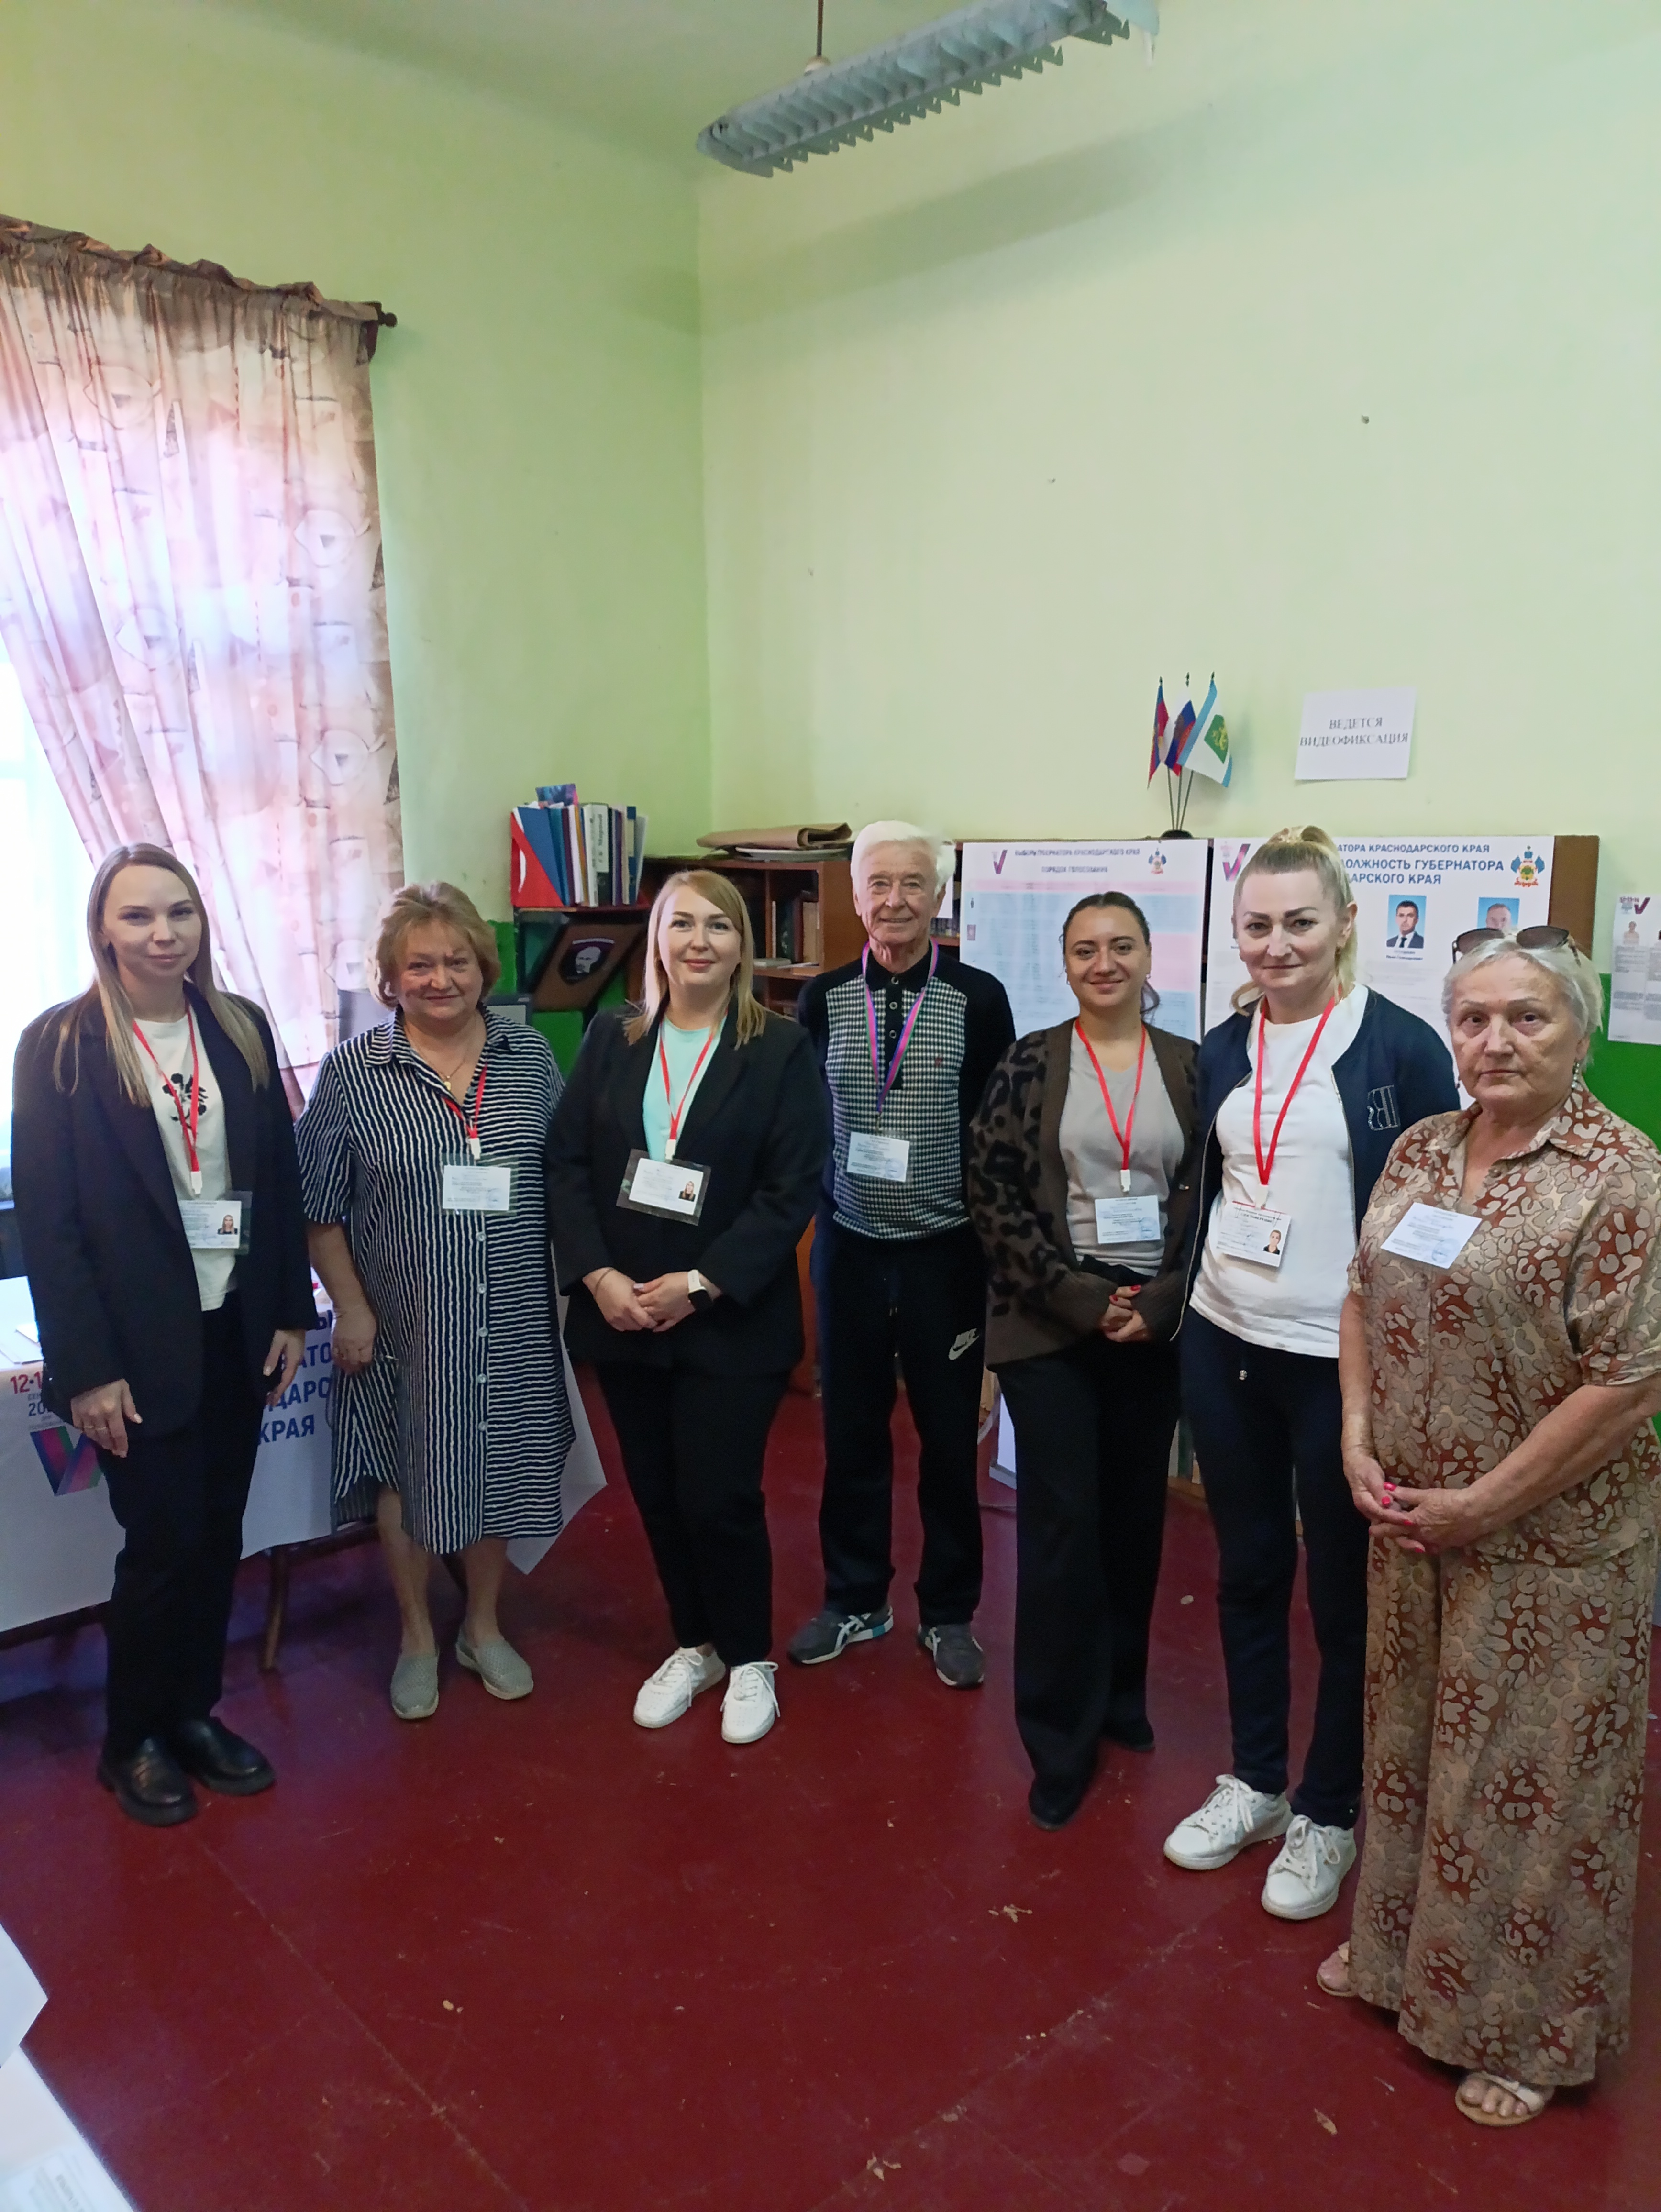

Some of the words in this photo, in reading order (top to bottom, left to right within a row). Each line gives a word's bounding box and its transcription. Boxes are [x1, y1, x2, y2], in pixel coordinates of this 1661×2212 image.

[1329, 717, 1383, 730] ВЕДЕТСЯ
[1300, 733, 1408, 747] ВИДЕОФИКСАЦИЯ
[1369, 844, 1459, 853] КРАСНОДАРСКОГО
[1462, 844, 1490, 852] КРАЯ
[1343, 859, 1411, 870] ОЛЖНОСТЬ
[1415, 860, 1504, 871] ГУБЕРНАТОРА
[1351, 874, 1405, 884] АРСКОГО
[1408, 874, 1441, 885] КРАЯ
